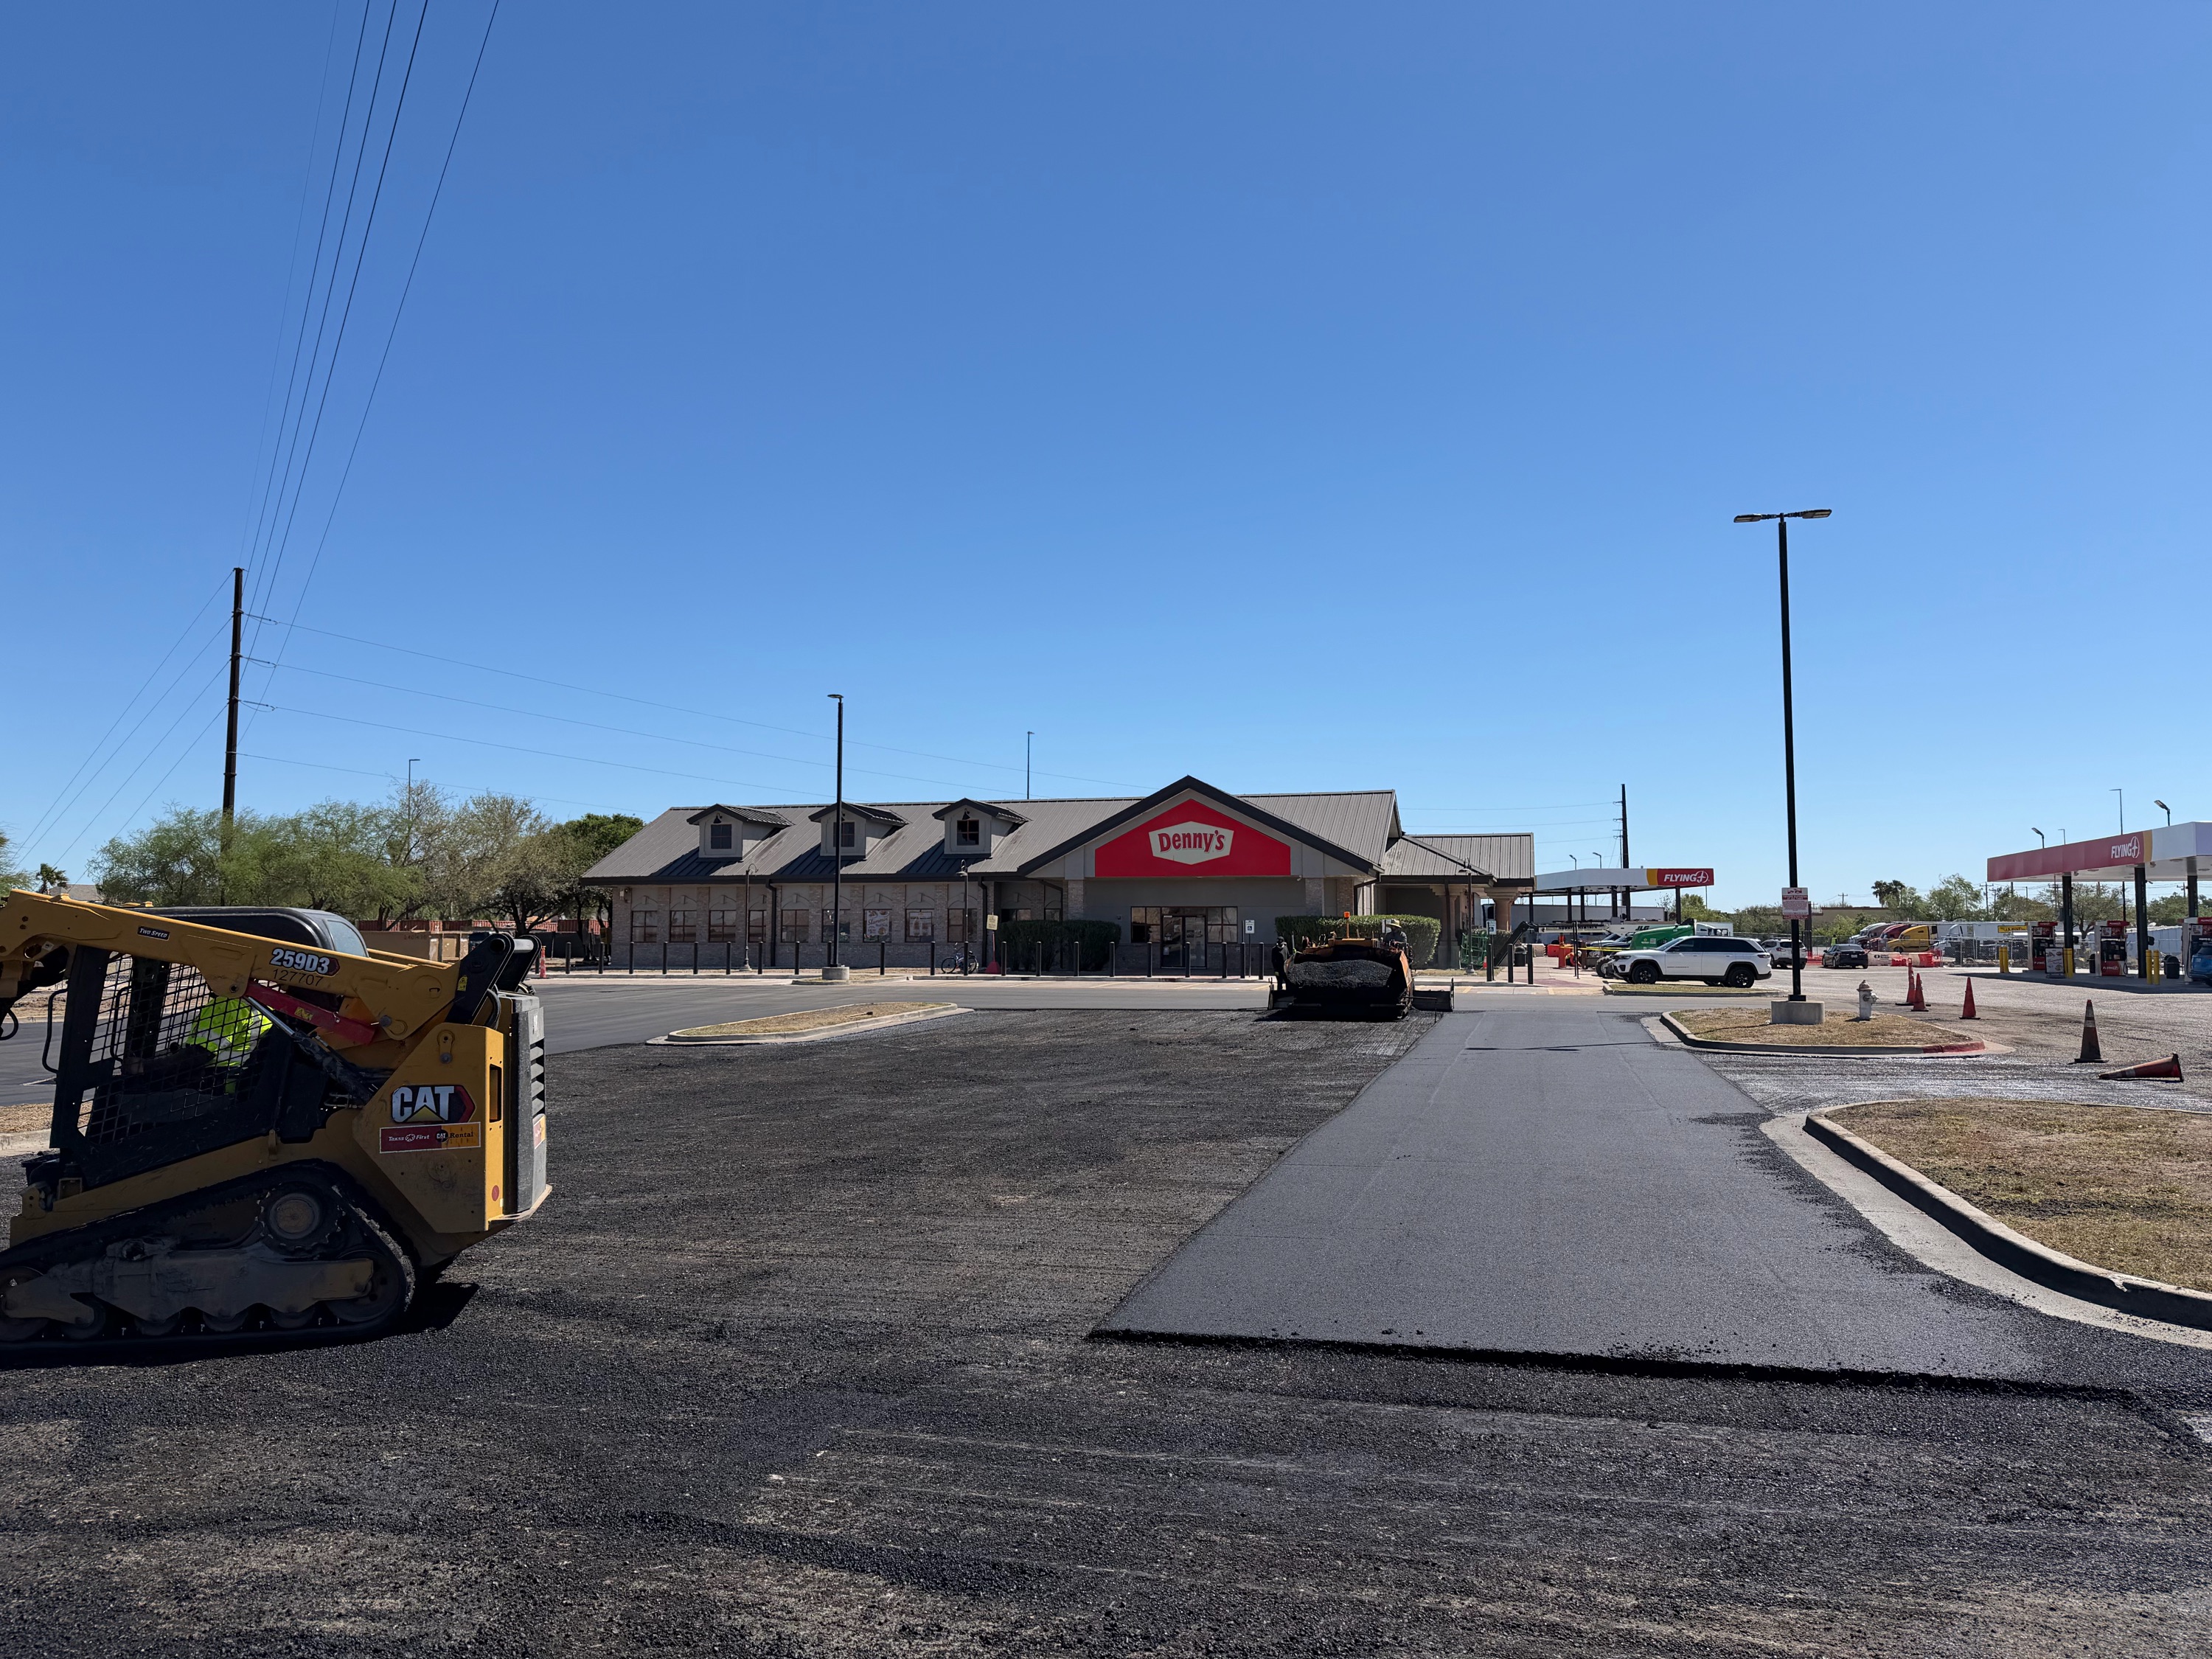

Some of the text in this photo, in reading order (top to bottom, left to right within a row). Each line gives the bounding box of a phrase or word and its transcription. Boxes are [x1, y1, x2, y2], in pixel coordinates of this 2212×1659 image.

[1157, 830, 1225, 852] Denny's
[2111, 843, 2132, 859] FLYING
[1663, 874, 1697, 883] FLYING
[270, 948, 330, 974] 259D3
[273, 968, 324, 987] 127707
[392, 1085, 455, 1122] CAT
